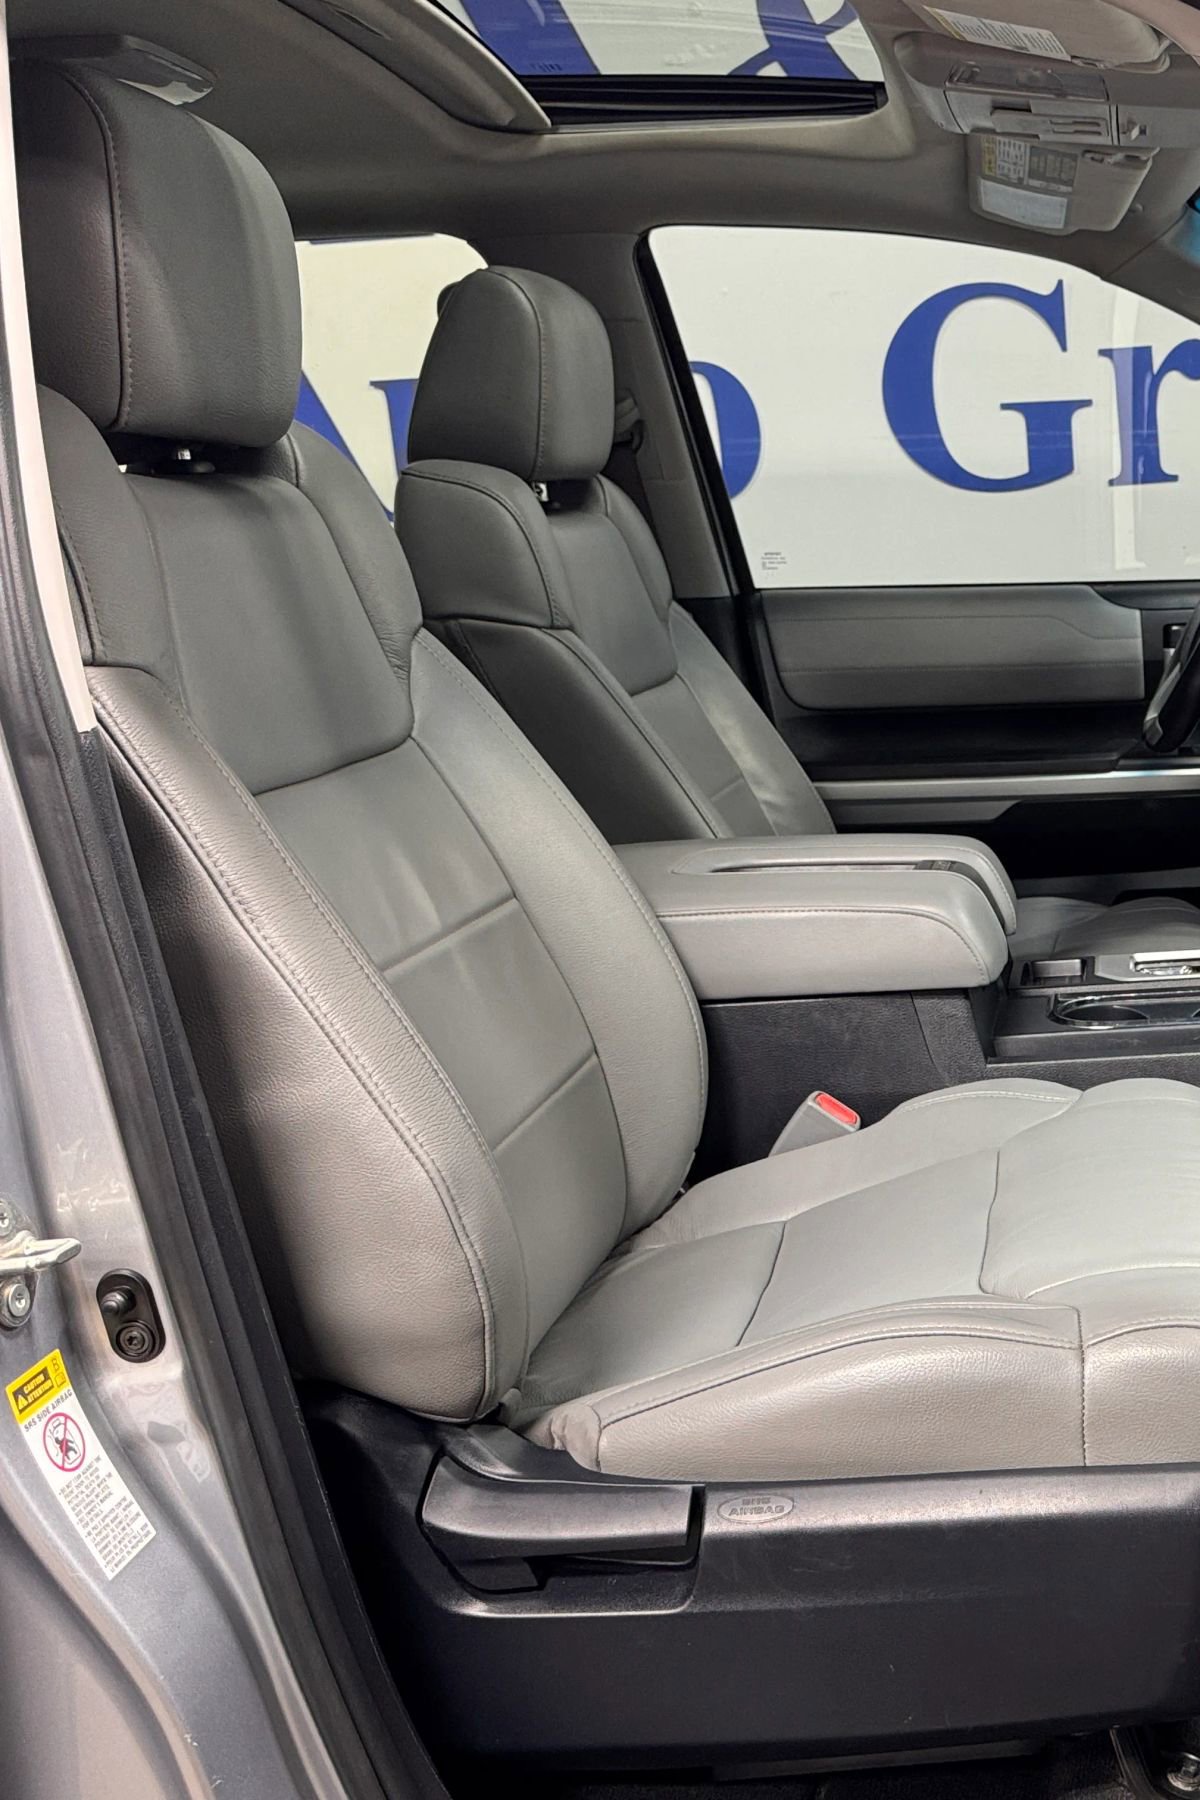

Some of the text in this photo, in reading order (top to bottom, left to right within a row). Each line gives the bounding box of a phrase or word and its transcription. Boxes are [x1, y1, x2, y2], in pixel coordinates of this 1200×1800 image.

[24, 1388, 73, 1433] SRS SIDE AIRBAG
